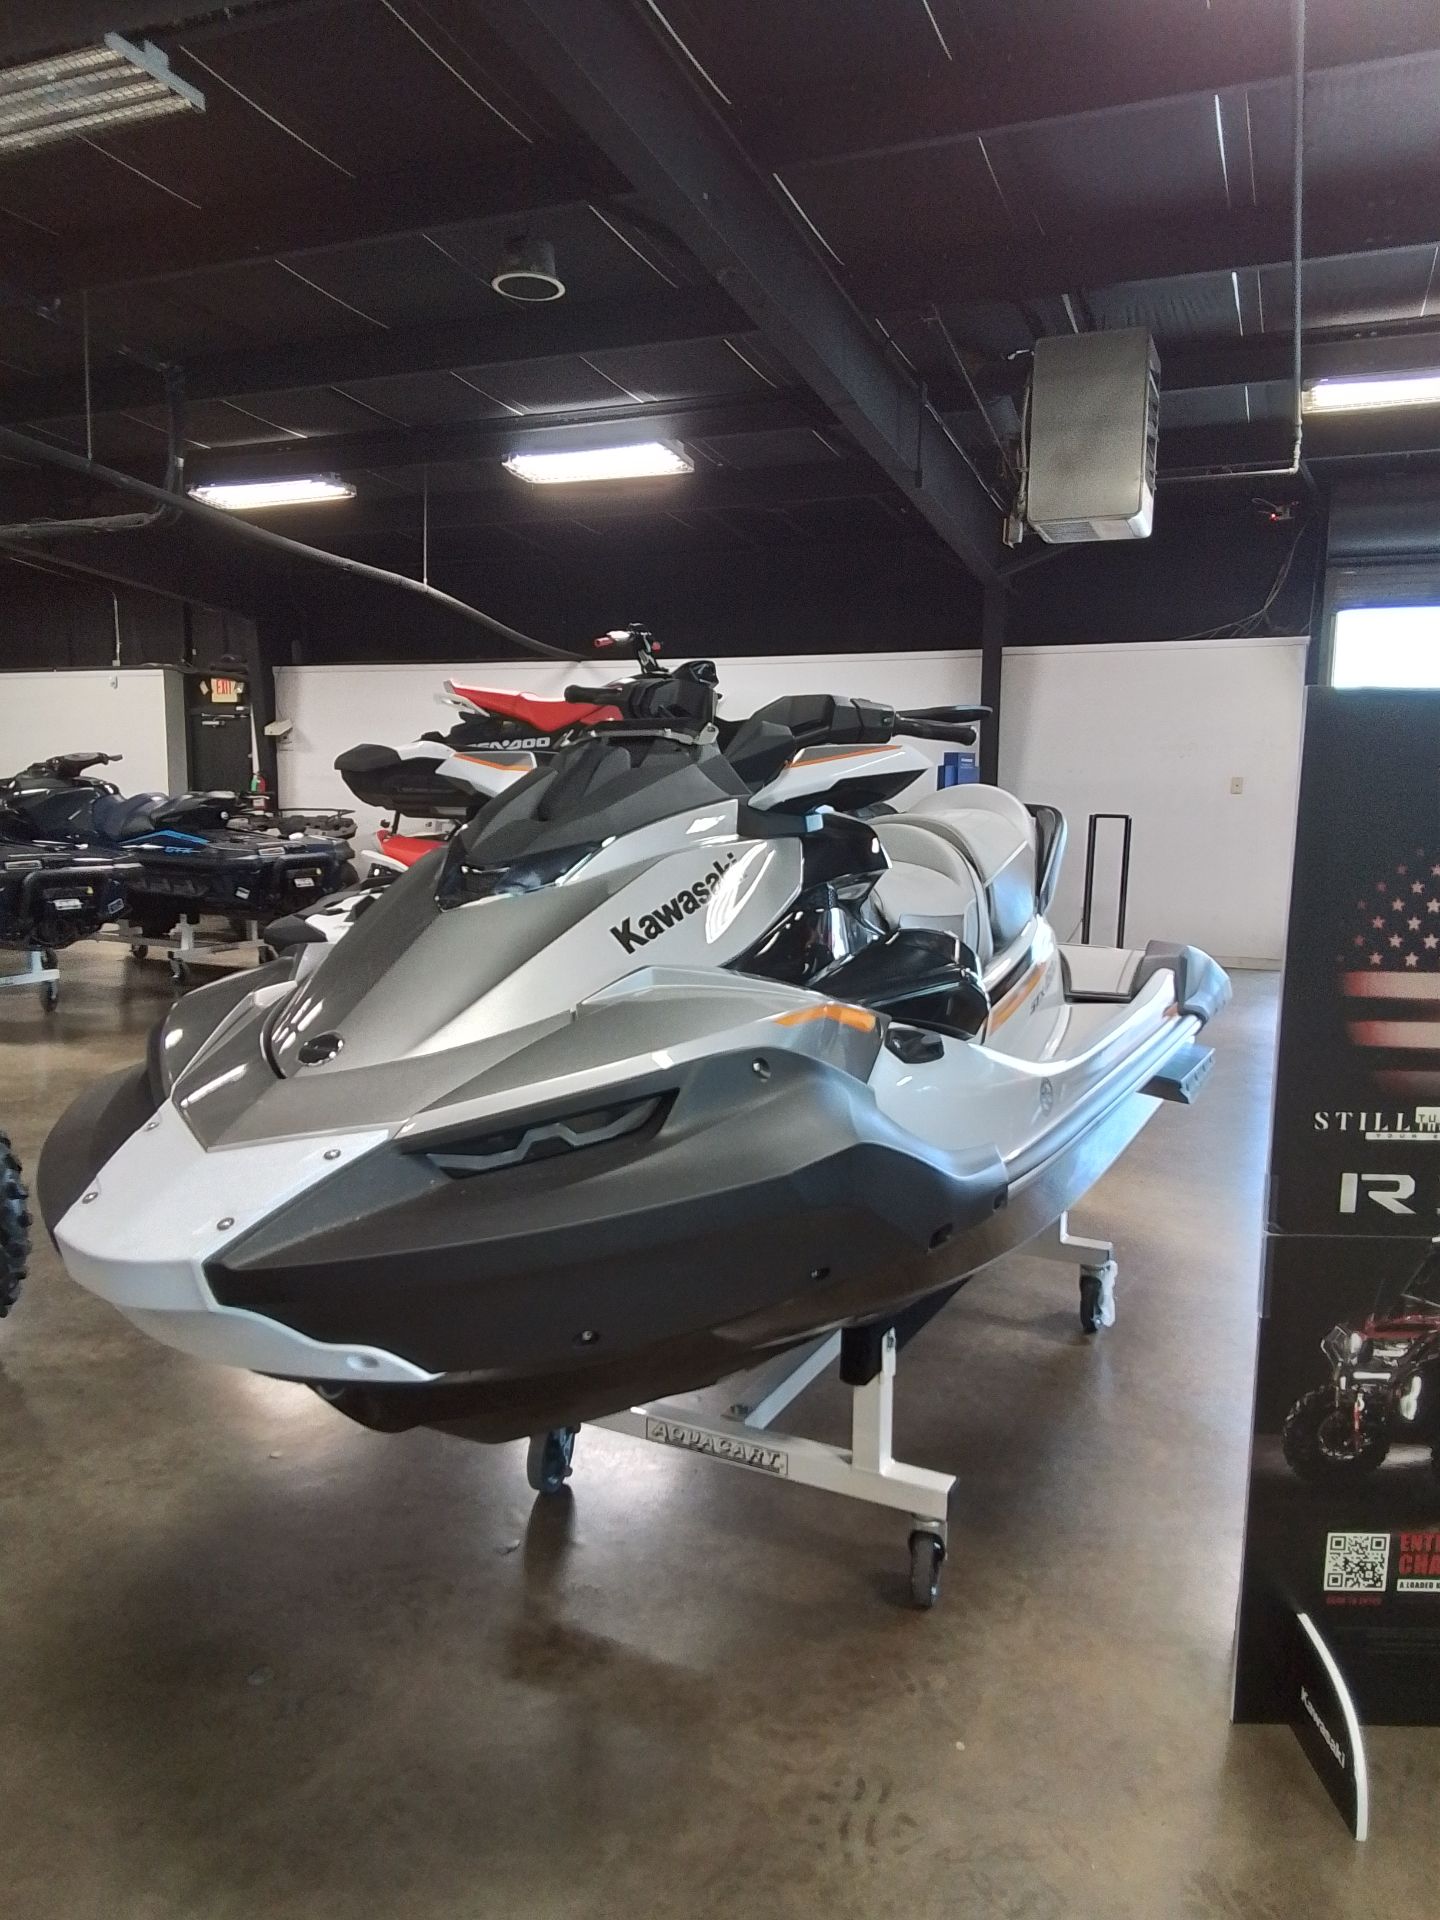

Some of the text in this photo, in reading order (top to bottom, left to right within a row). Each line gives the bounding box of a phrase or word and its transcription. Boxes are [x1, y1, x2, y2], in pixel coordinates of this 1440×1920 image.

[217, 679, 232, 695] EXIT
[1314, 1111, 1440, 1132] STILL TH
[1301, 1685, 1345, 1769] Kawasaki
